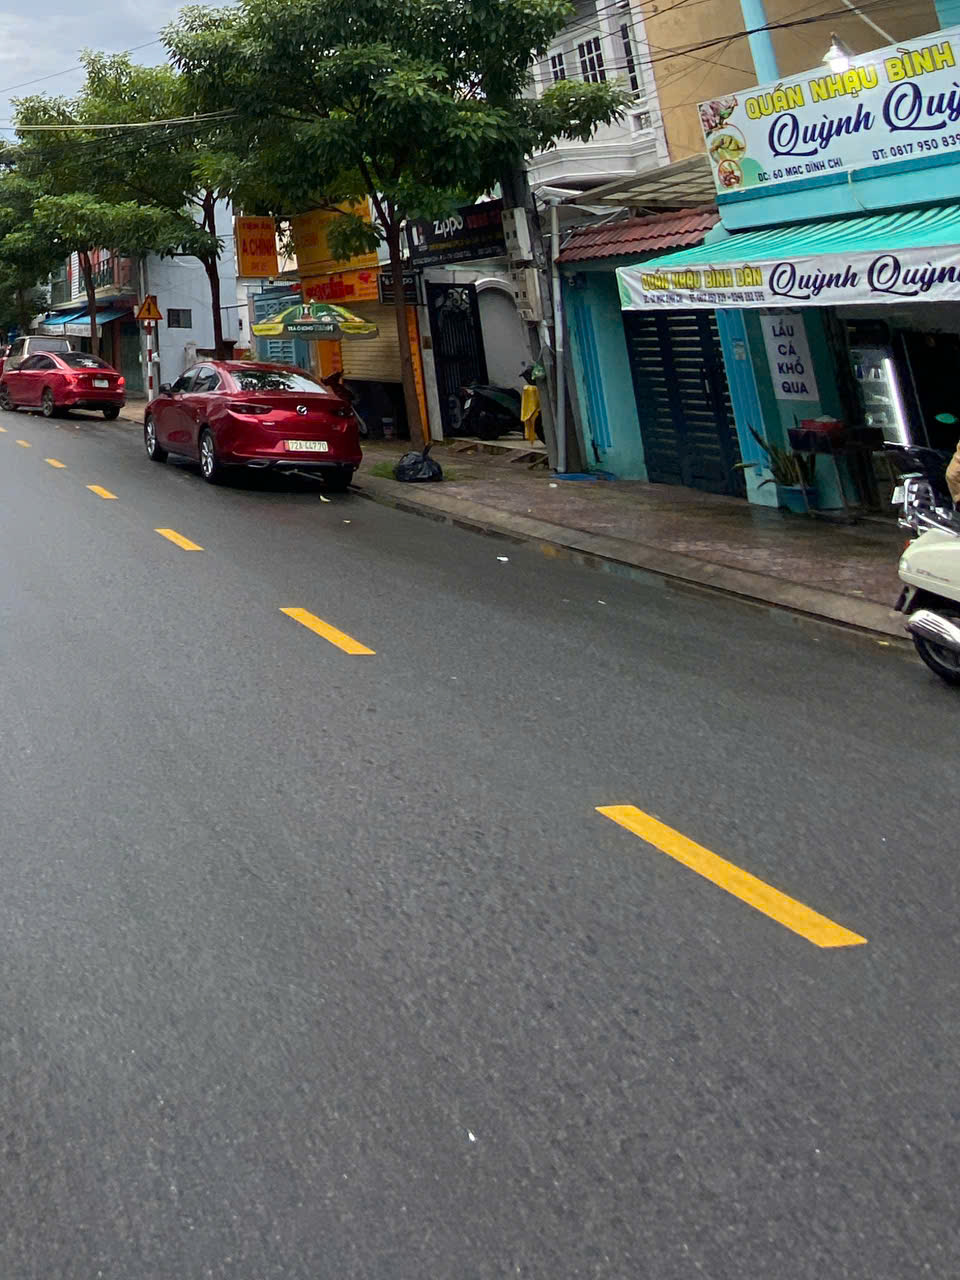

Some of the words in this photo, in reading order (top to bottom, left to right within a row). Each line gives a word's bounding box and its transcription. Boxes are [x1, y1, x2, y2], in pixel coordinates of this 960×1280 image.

[745, 83, 805, 120] QUÁN
[883, 41, 956, 83] BÌNH
[768, 103, 876, 158] Quỳnh
[828, 157, 843, 168] CHI
[890, 143, 913, 157] 0817
[917, 138, 938, 152] 950
[704, 264, 734, 288] BÌNH
[769, 262, 860, 299] Quỳnh
[867, 255, 960, 296] Quỳn
[778, 340, 797, 356] CÁ
[782, 381, 808, 395] QUA
